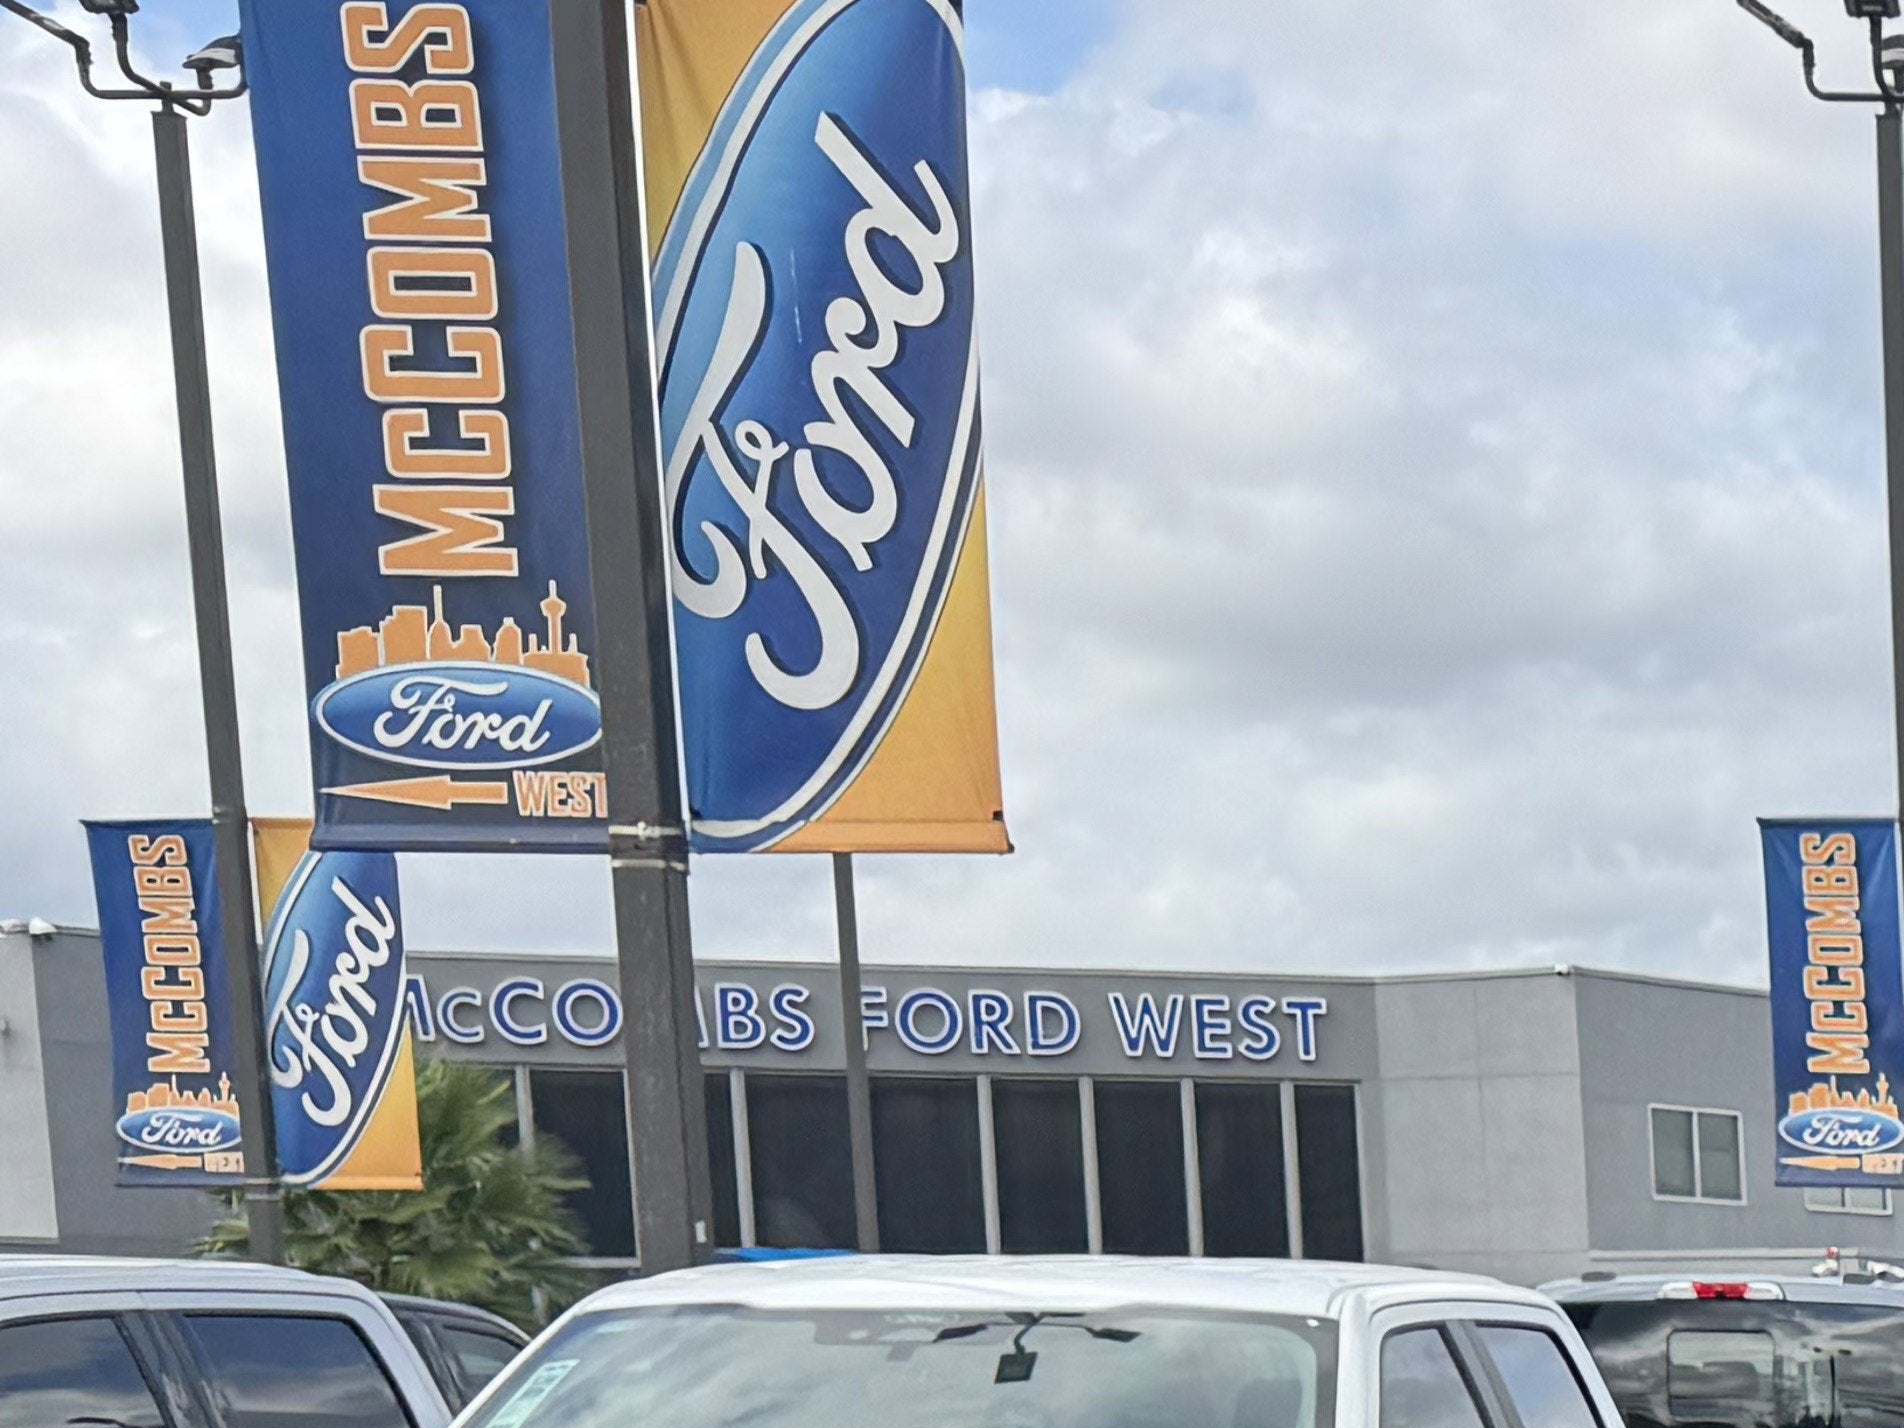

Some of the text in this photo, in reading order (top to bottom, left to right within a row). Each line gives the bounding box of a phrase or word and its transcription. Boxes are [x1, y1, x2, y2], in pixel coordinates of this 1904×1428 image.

[343, 1, 519, 577] MCCOMBS
[671, 110, 960, 711] Ford
[373, 675, 551, 752] Ford
[512, 770, 609, 819] WEST
[128, 834, 211, 1073] MCCOMBS
[267, 876, 396, 1127] Ford
[405, 973, 815, 1051] cCOBS
[1108, 992, 1328, 1062] WEST
[1800, 832, 1870, 1075] MCCOMBS
[141, 1111, 224, 1146] Ford
[1802, 1118, 1882, 1147] Ford
